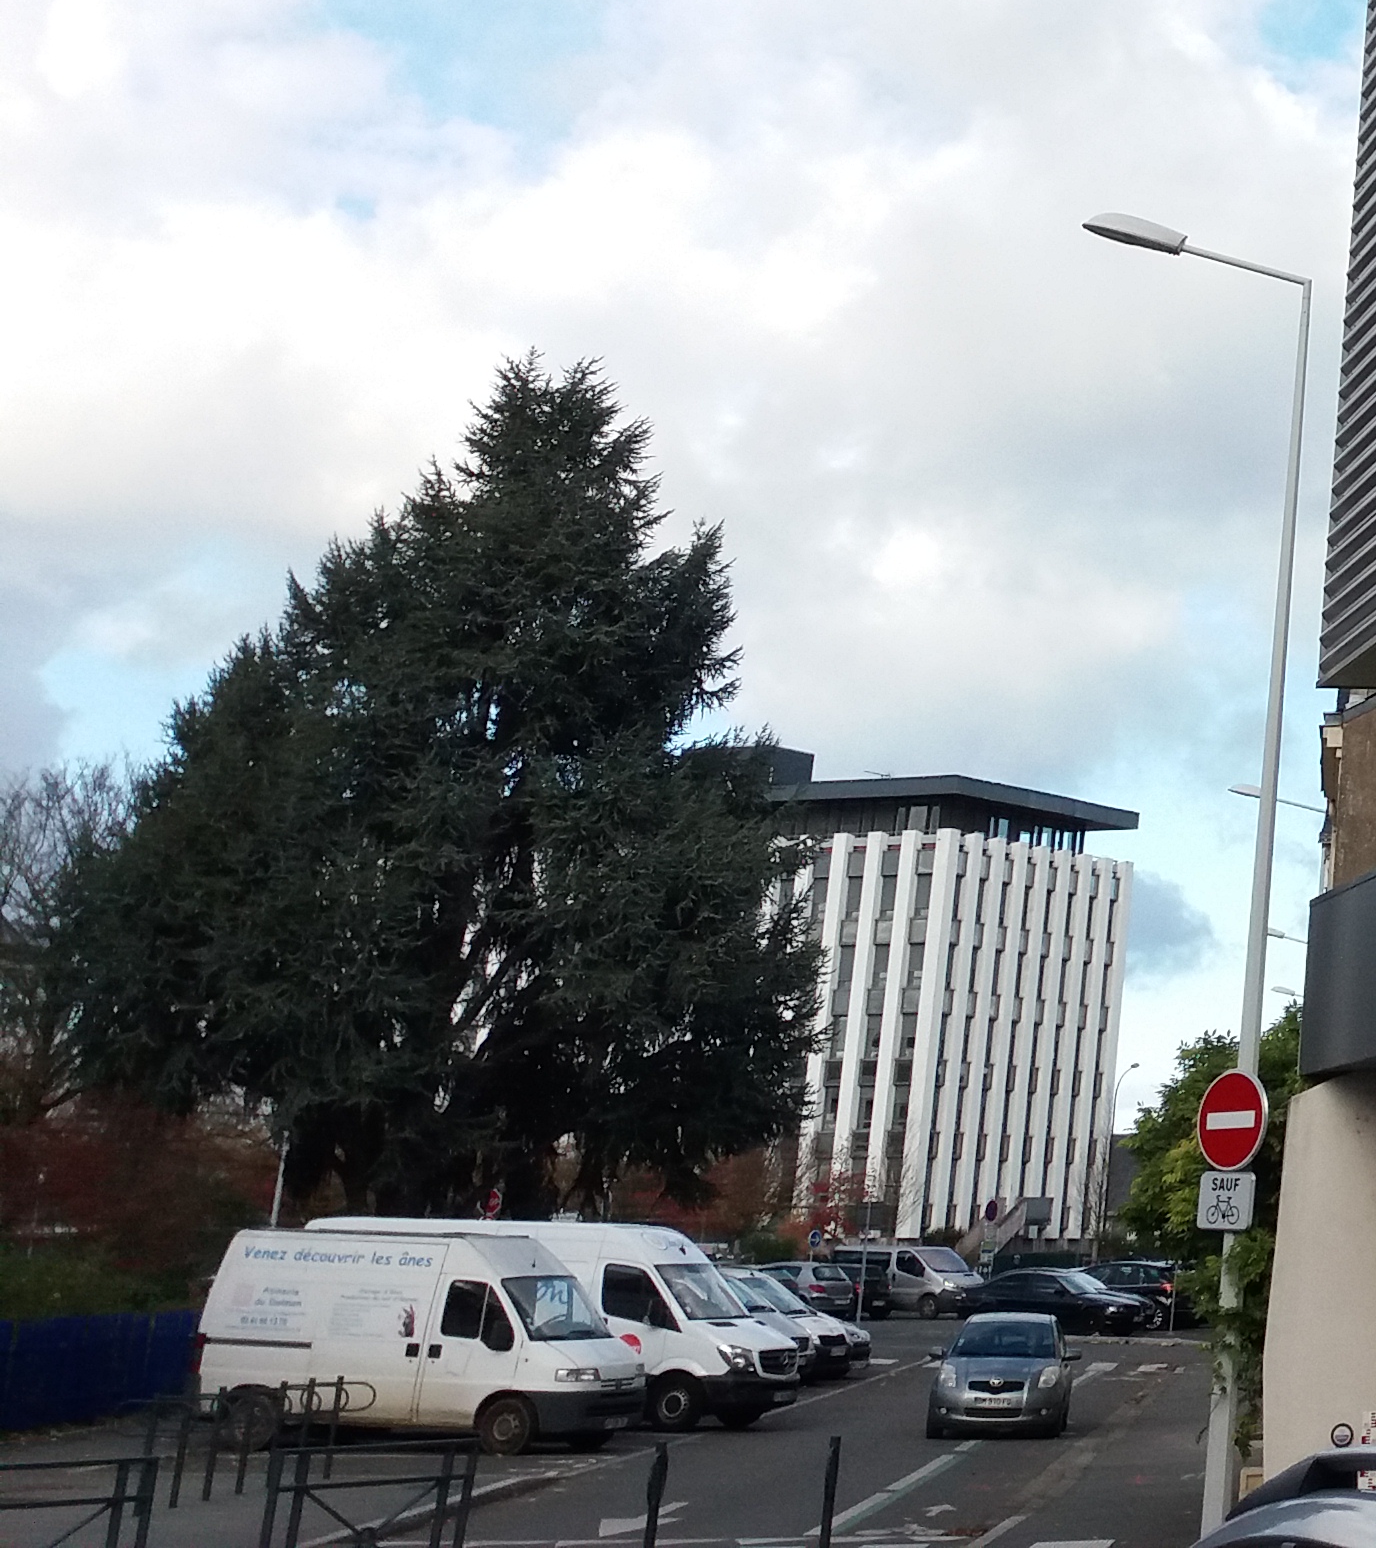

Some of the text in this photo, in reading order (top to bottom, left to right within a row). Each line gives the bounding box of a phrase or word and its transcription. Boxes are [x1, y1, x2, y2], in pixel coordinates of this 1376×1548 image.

[1211, 1177, 1241, 1192] SAUF
[244, 1245, 434, 1268] Venez découvrir les ânes
